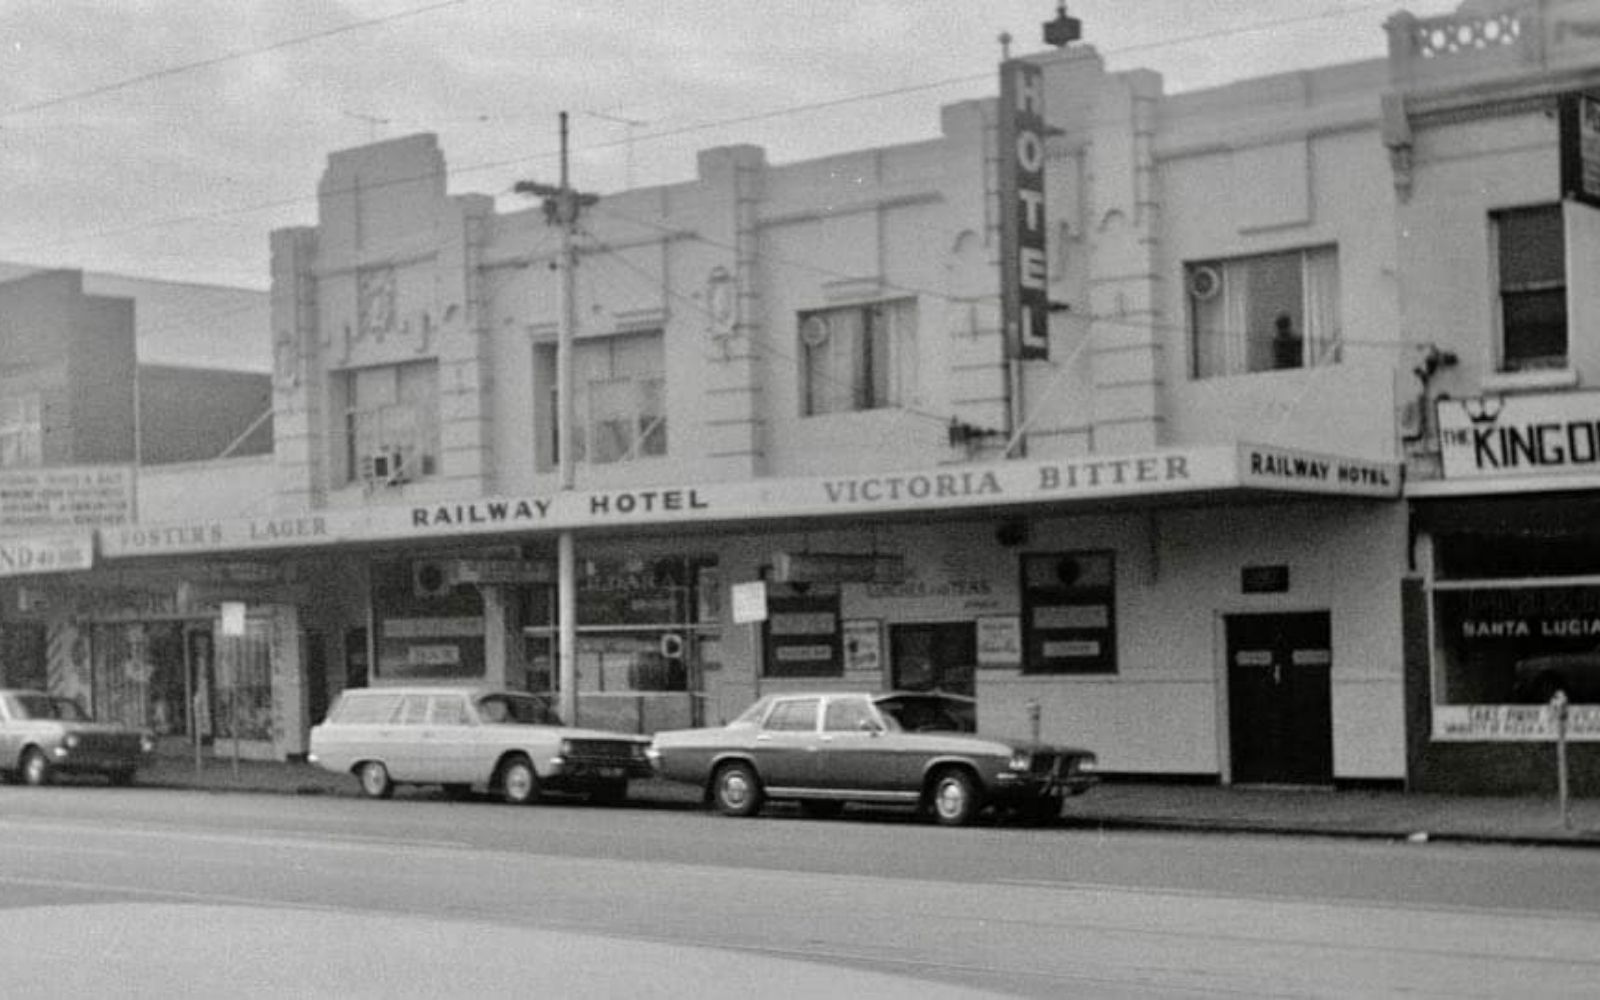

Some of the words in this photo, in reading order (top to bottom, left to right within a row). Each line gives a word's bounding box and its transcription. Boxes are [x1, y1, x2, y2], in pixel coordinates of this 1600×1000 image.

[1015, 68, 1048, 348] HOTEL
[824, 471, 1003, 503] VICTORIA
[1039, 456, 1191, 490] BITTER
[1251, 452, 1329, 480] RAILWAY
[1338, 463, 1390, 487] HOTEL
[412, 498, 552, 527] RAILWAY
[590, 489, 709, 515] HOTEL
[251, 517, 326, 541] LAGER
